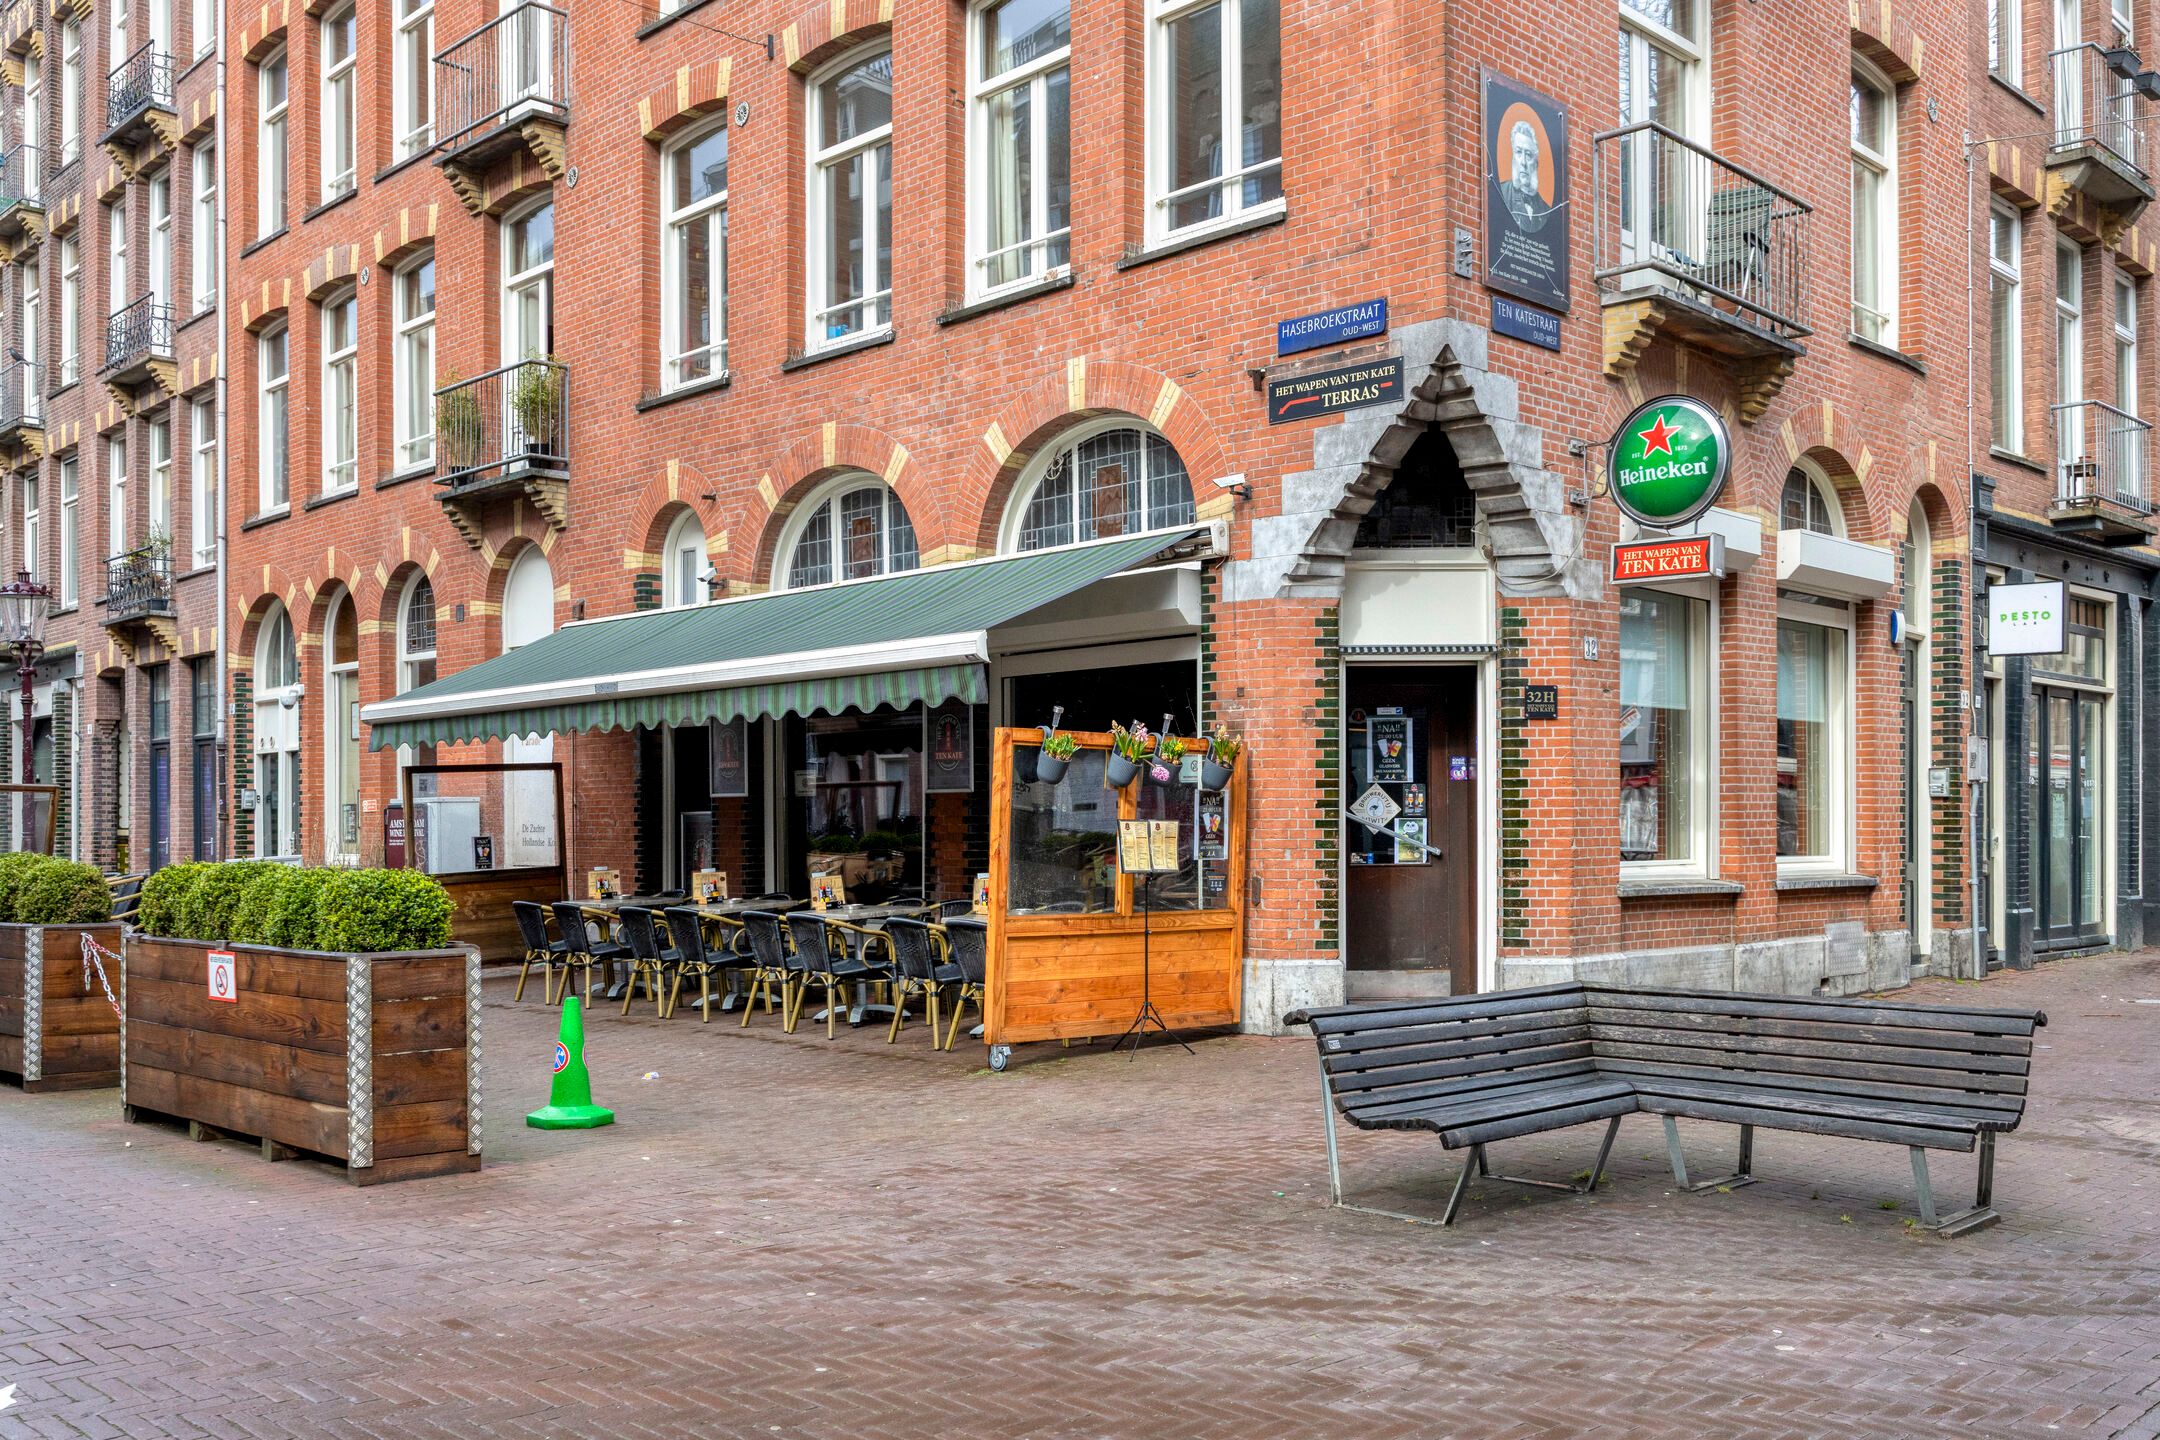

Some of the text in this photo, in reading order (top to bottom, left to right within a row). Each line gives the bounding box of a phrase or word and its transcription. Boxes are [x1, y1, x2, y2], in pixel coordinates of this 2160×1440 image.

[1281, 303, 1381, 338] HASEBROEKSTRAAT
[1497, 301, 1558, 333] TEN KATESTRAAT
[1342, 320, 1380, 336] OUD-WEST
[1533, 331, 1558, 345] OUD-WEST
[1275, 365, 1396, 397] HET WAPEN VAN TEN KATE
[1321, 383, 1380, 407] TERRAS
[1623, 545, 1701, 561] HET WAPEN VAN
[1622, 555, 1702, 575] TEN KATE
[2000, 611, 2051, 622] PESTO
[1585, 639, 1597, 657] 32
[935, 752, 964, 760] TEN KATE
[522, 823, 529, 833] De
[522, 837, 545, 846] Hollandse
